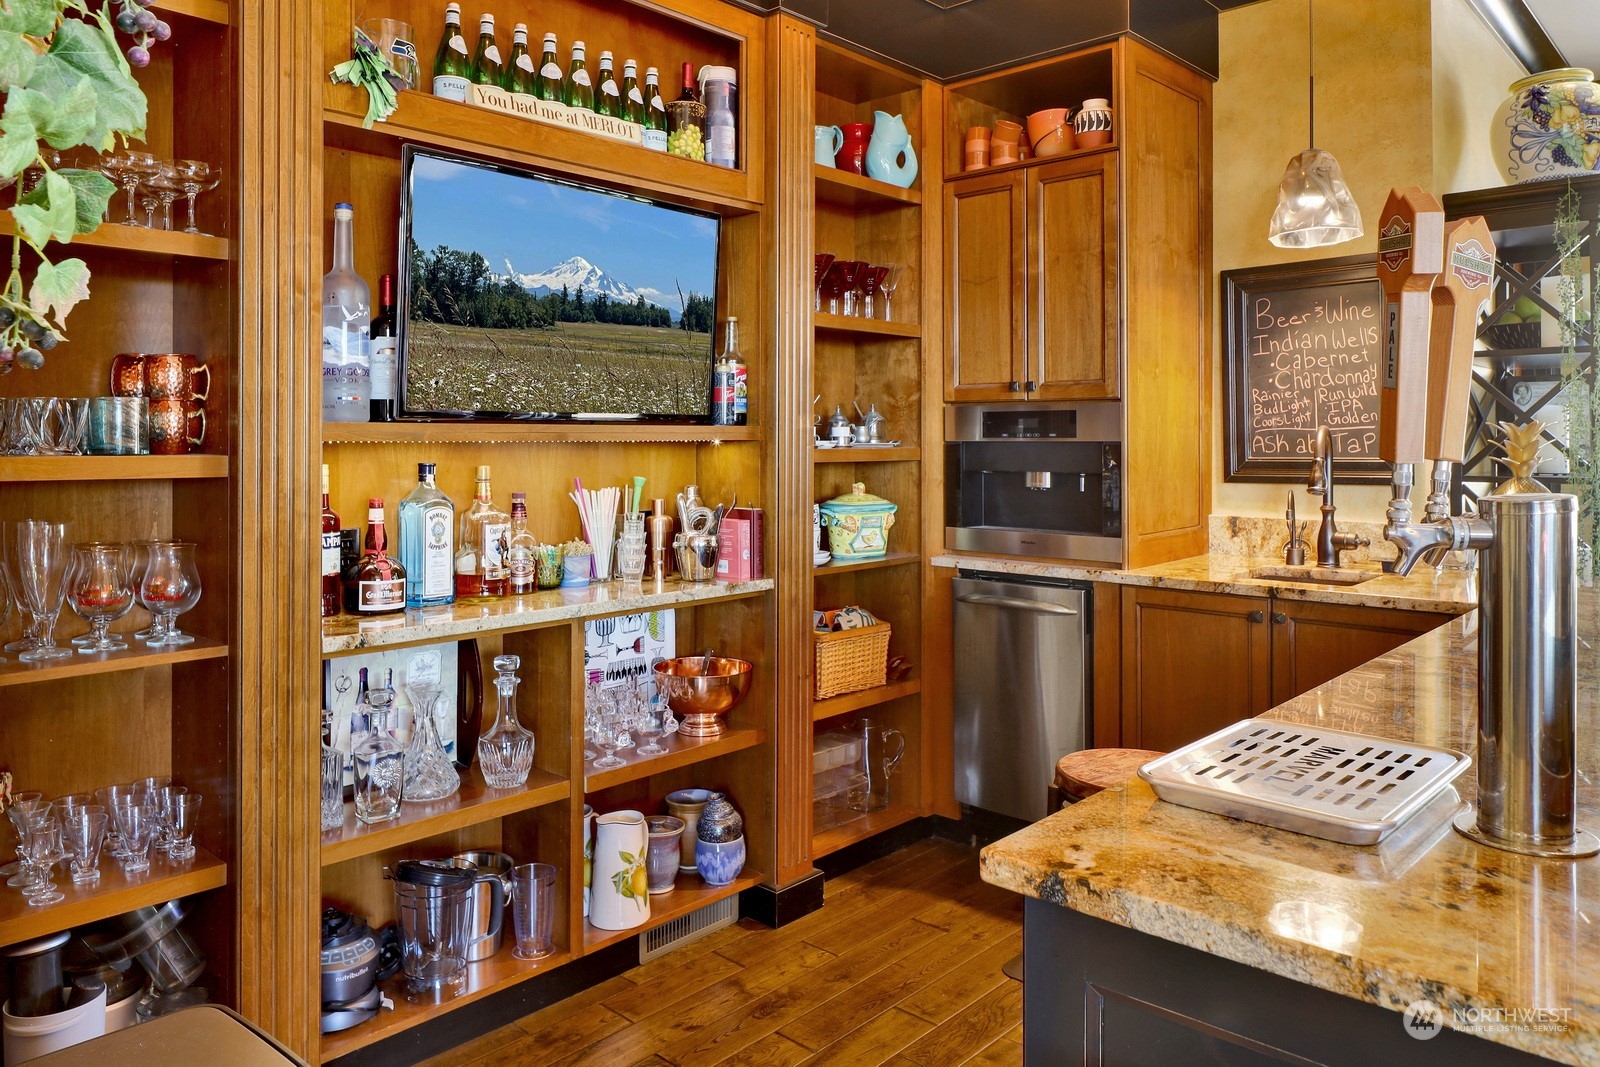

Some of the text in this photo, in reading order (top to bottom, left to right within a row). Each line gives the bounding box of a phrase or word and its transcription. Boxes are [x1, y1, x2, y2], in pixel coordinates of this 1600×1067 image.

[477, 87, 634, 138] You had me at MERLOT
[1256, 298, 1311, 330] Beer
[1325, 296, 1374, 324] Wine
[1253, 327, 1378, 356] Indian Wells
[1388, 311, 1396, 379] PALE
[1275, 348, 1369, 371] Cabernet
[322, 367, 343, 376] GREY
[1275, 363, 1377, 390] Chardonnay
[1252, 388, 1300, 403] Rainier
[1318, 387, 1345, 404] Run
[1253, 396, 1311, 416] Bud Light
[1327, 399, 1364, 413] IPA
[1284, 411, 1312, 429] Light
[1327, 411, 1378, 425] Golden
[427, 541, 448, 551] SAPPHIRE
[1262, 745, 1346, 783] MARVEL
